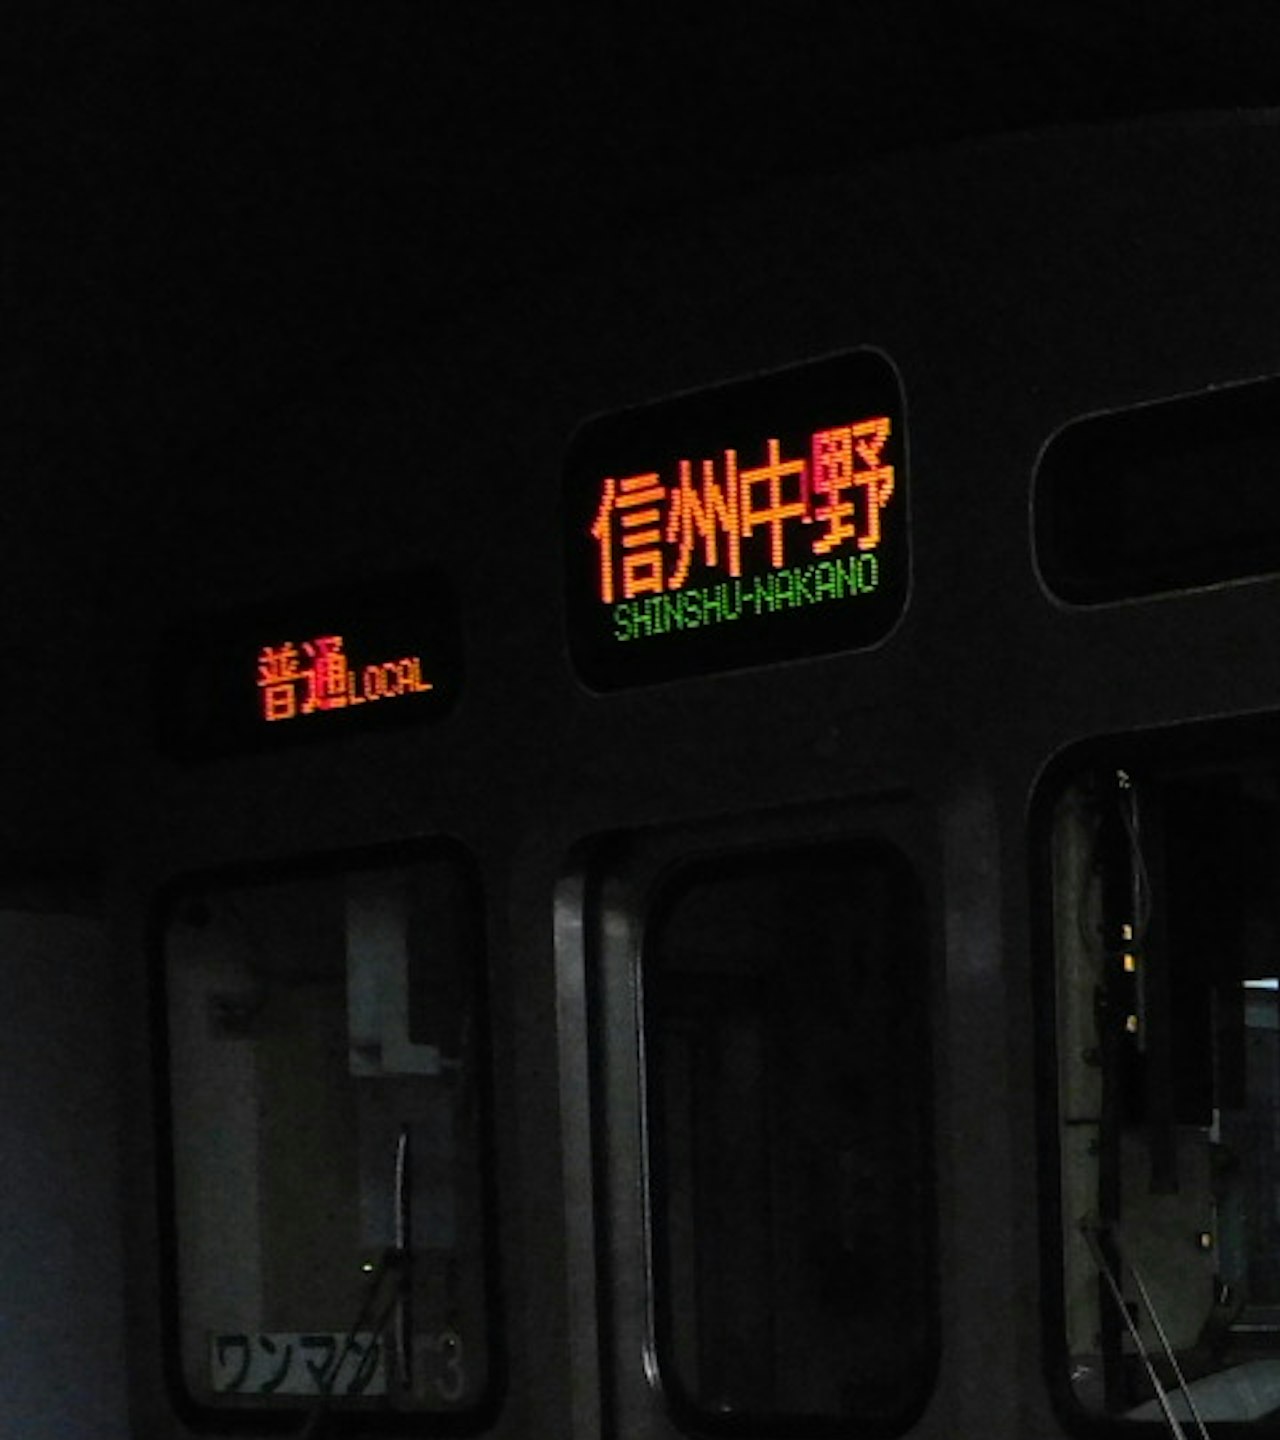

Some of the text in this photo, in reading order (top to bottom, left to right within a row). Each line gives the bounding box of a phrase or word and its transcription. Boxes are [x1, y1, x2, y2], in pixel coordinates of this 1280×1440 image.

[591, 417, 895, 604] 信州中野
[613, 553, 879, 641] SHINSHU-NAKANO
[257, 635, 433, 721] 普通 LOCAL
